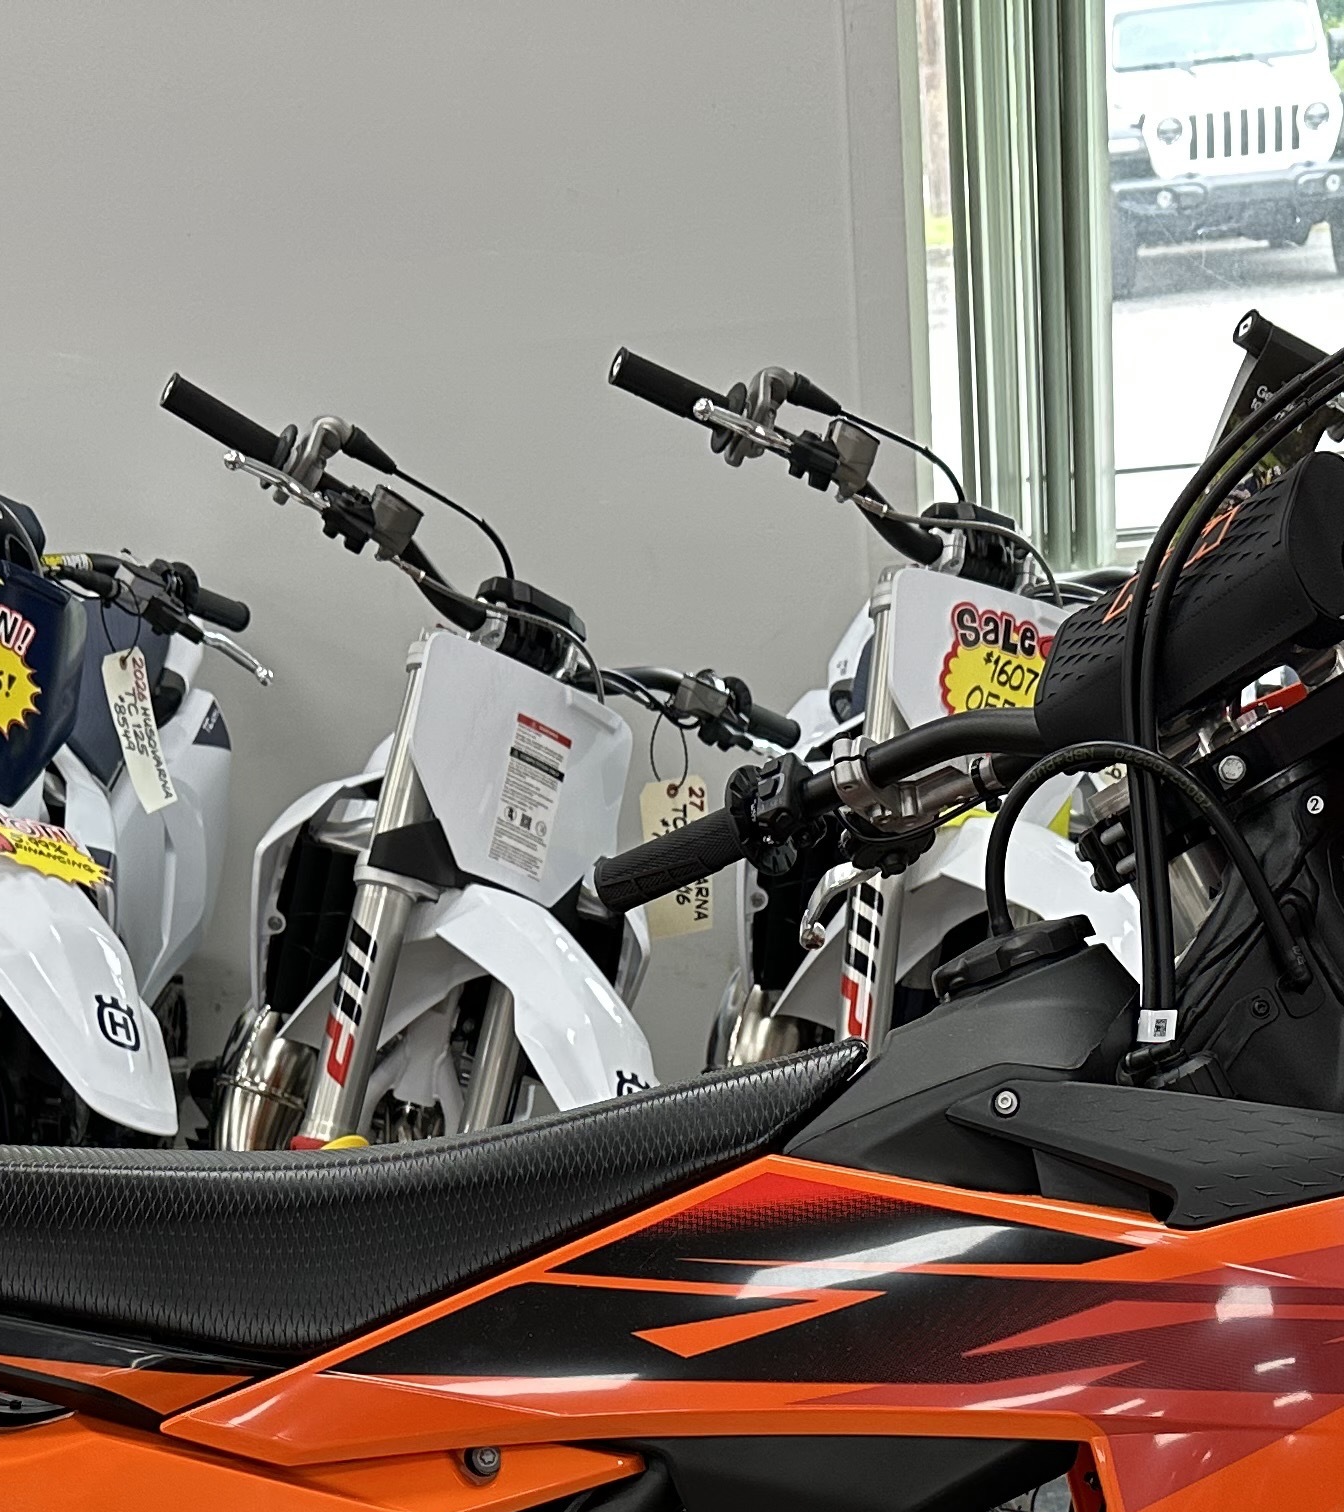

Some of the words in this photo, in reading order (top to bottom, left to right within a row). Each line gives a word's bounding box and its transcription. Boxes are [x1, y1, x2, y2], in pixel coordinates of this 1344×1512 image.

[954, 605, 1038, 658] Sale
[983, 651, 1040, 696] $1607
[125, 688, 139, 717] TC
[132, 723, 150, 757] 125
[132, 656, 148, 703] 2026
[141, 706, 173, 799] HUSQVARNA
[688, 785, 705, 812] 27
[14, 842, 96, 874] FINANCING
